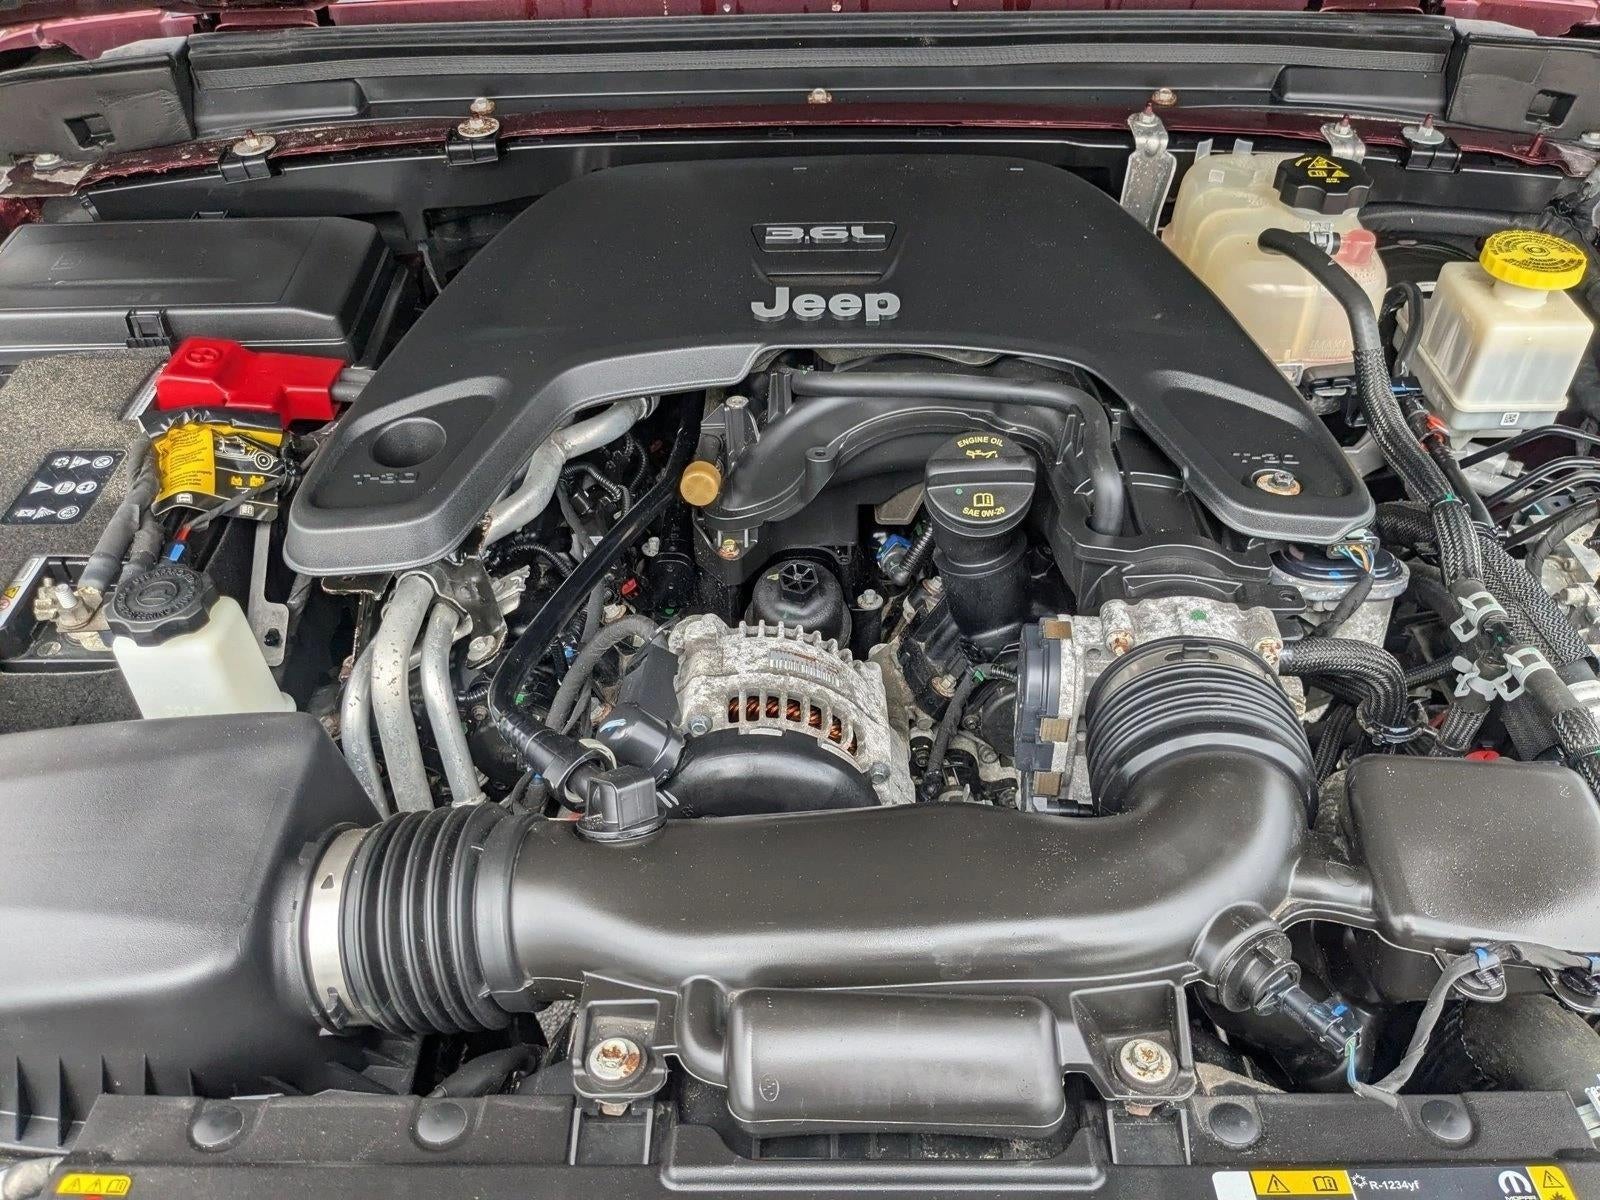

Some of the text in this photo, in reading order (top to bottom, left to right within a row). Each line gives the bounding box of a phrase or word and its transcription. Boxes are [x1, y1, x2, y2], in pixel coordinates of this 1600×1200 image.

[765, 226, 886, 244] 3.6L
[751, 286, 901, 325] Jeep
[957, 436, 1004, 448] ENGINE OIL
[962, 506, 1006, 518] SAE 0W-20
[1368, 1180, 1420, 1191] R-1234yf
